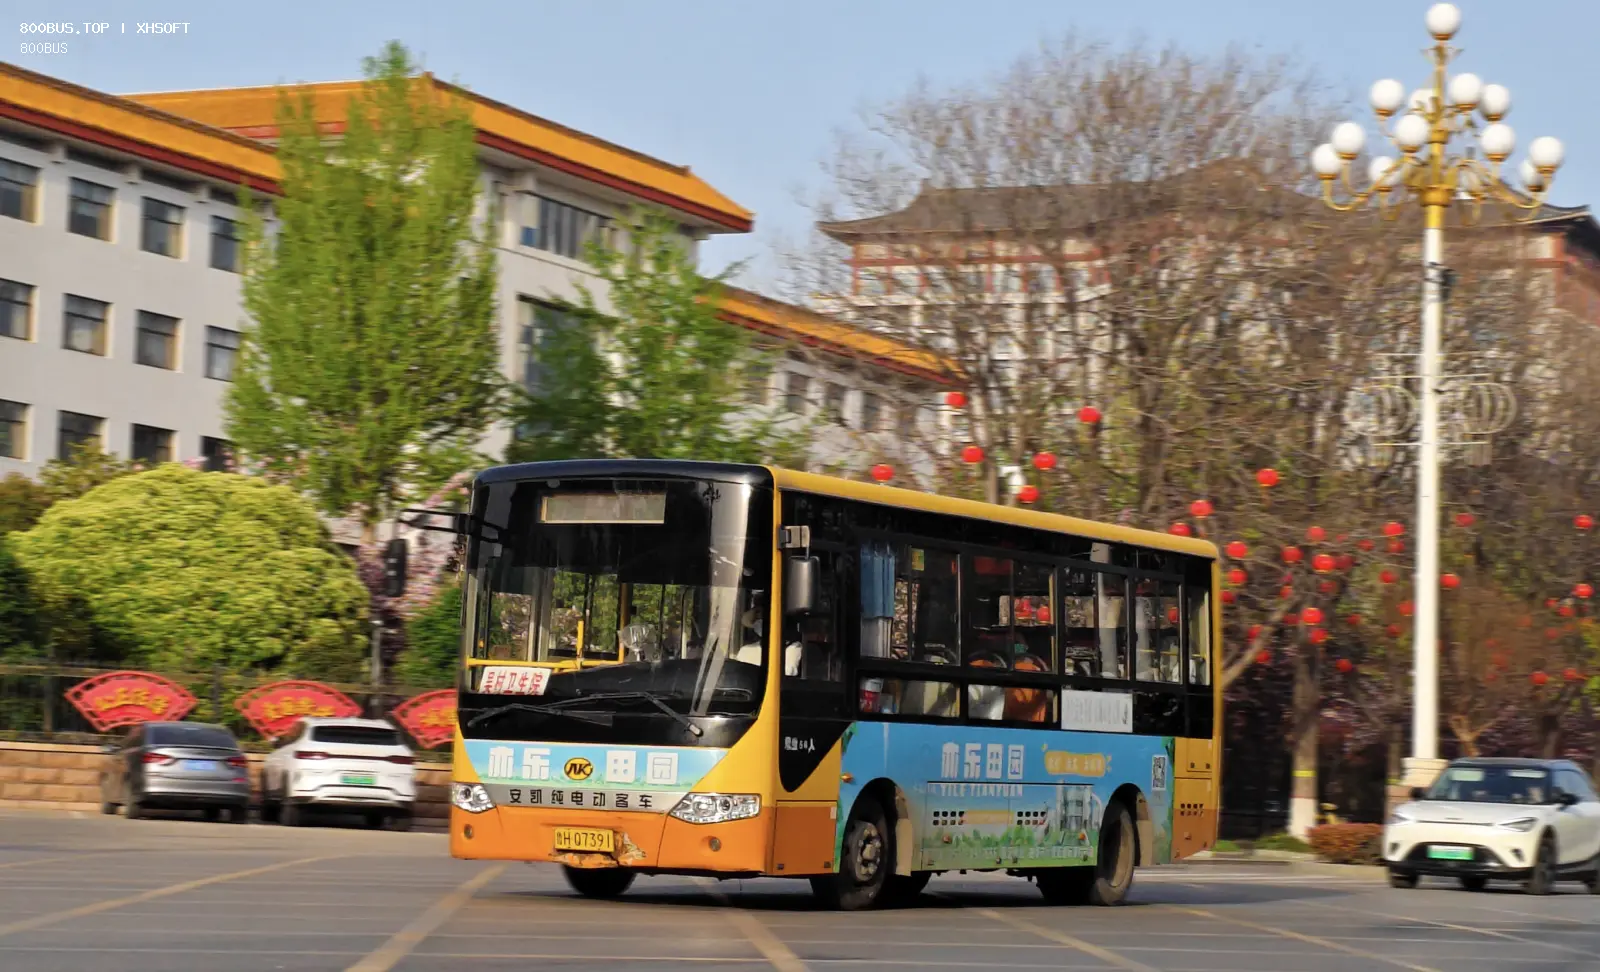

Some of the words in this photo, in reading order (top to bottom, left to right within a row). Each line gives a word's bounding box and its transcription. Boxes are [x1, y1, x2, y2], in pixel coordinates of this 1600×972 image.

[509, 788, 653, 808] 安凯纯电动客车
